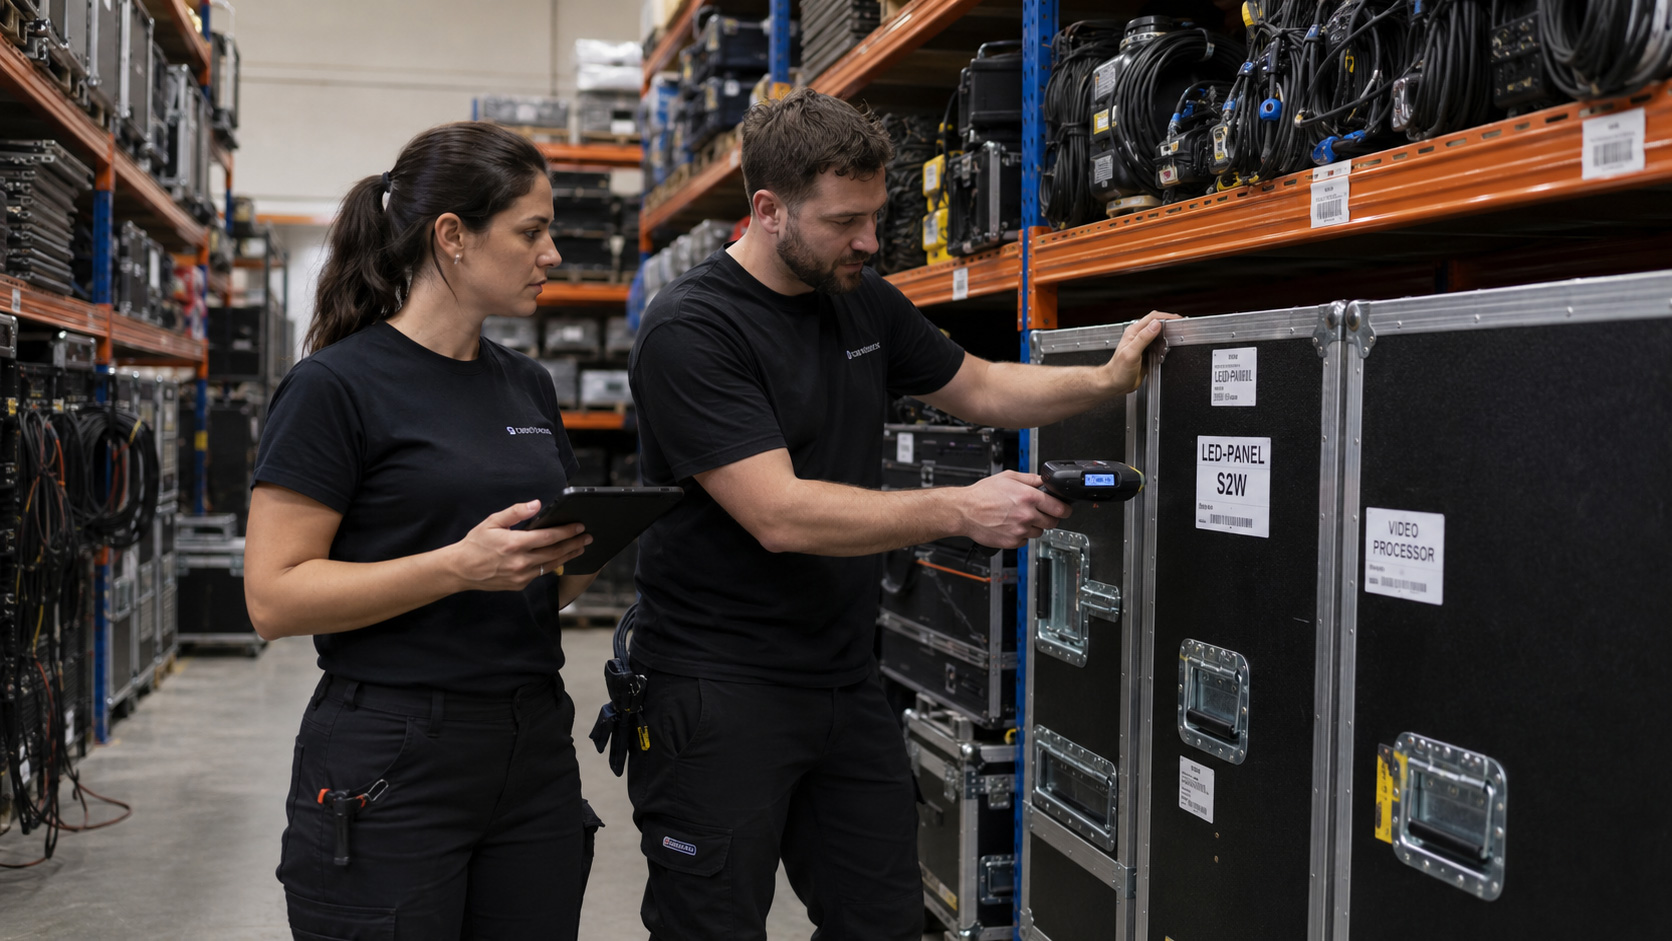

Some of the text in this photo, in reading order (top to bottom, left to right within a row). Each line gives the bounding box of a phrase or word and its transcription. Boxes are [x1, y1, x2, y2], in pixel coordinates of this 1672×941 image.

[1202, 443, 1265, 465] LED-PANEL
[1216, 471, 1248, 497] S2W
[1388, 520, 1419, 538] VIDEO
[1373, 540, 1435, 562] PROCESSOR
